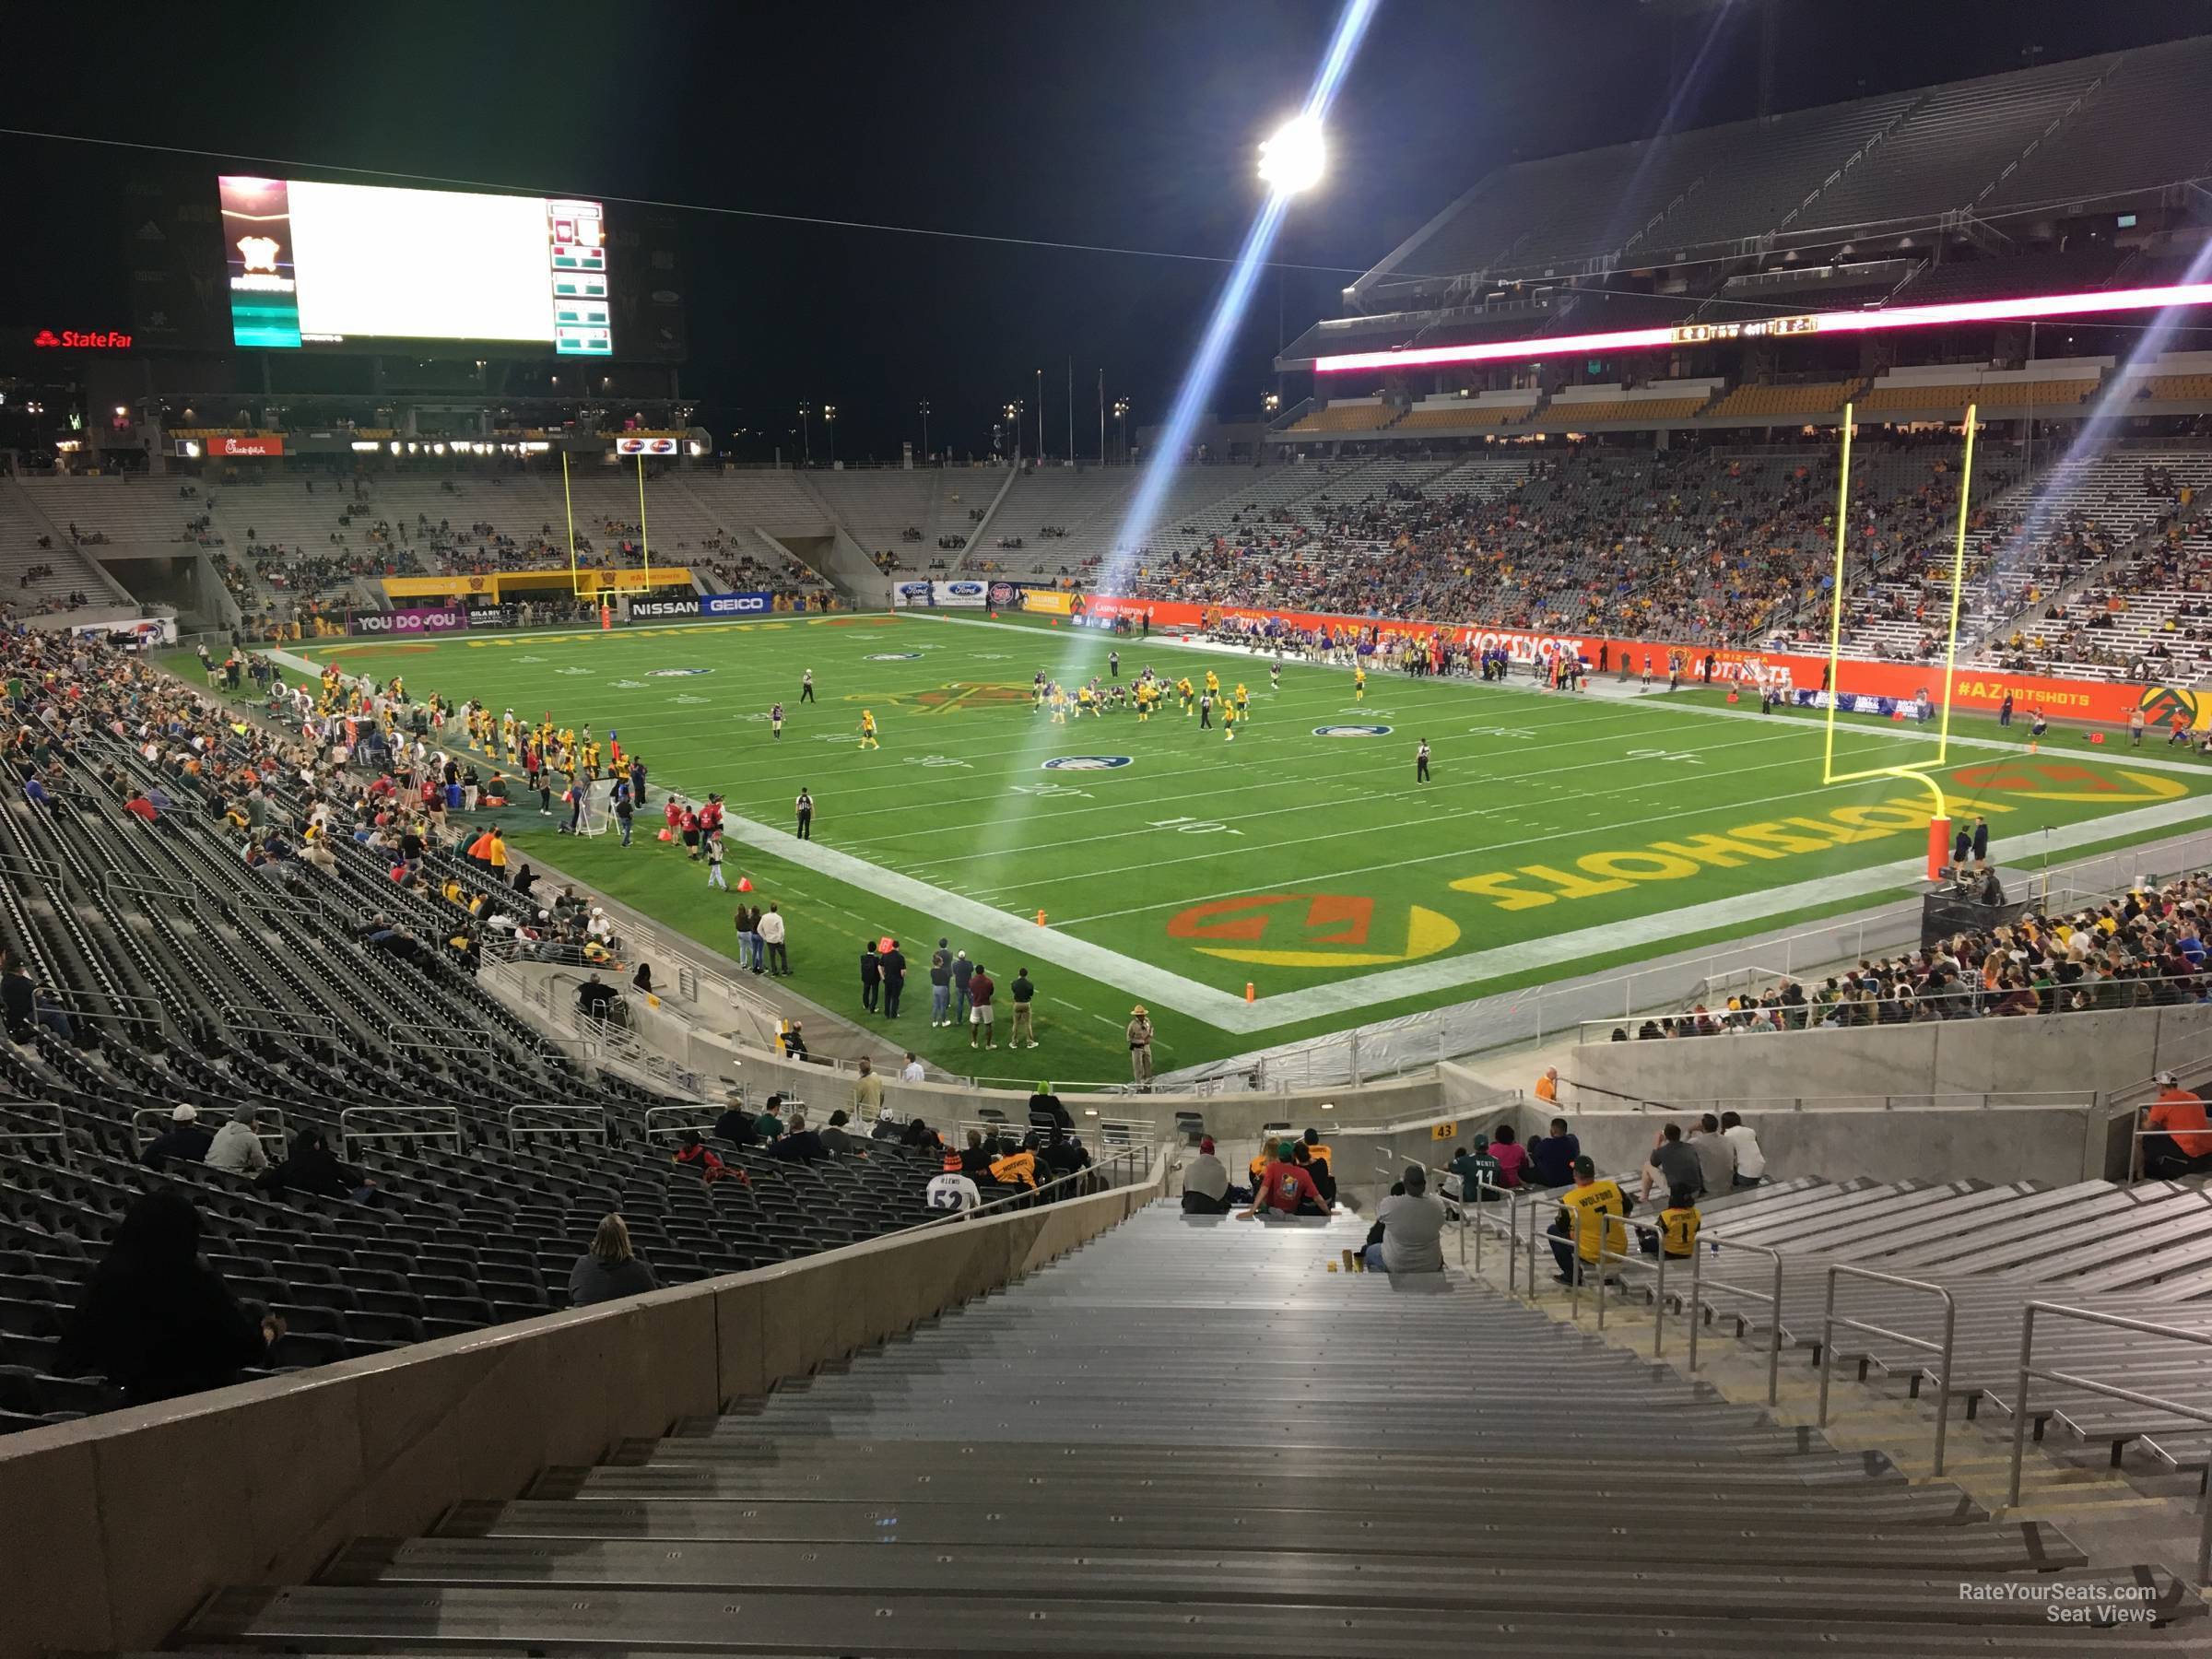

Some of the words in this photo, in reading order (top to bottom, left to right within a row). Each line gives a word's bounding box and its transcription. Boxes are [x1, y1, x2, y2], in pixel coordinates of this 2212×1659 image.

[955, 584, 977, 594] Ford
[633, 602, 699, 616] NISSAN
[710, 597, 763, 611] GEICO
[358, 617, 393, 630] YOU
[396, 615, 420, 629] DO
[1333, 623, 1427, 642] ARNA
[1714, 653, 1769, 664] ARIZA
[1694, 659, 1791, 683] HOTSHTS
[1448, 792, 2019, 912] HOTSHOTS
[1438, 1124, 1452, 1137] 43
[1476, 1170, 1493, 1185] 11
[934, 1190, 962, 1209] 52
[1579, 1189, 1614, 1207] WOLFORD
[1594, 1205, 1610, 1233] 7
[1682, 1222, 1688, 1243] 1
